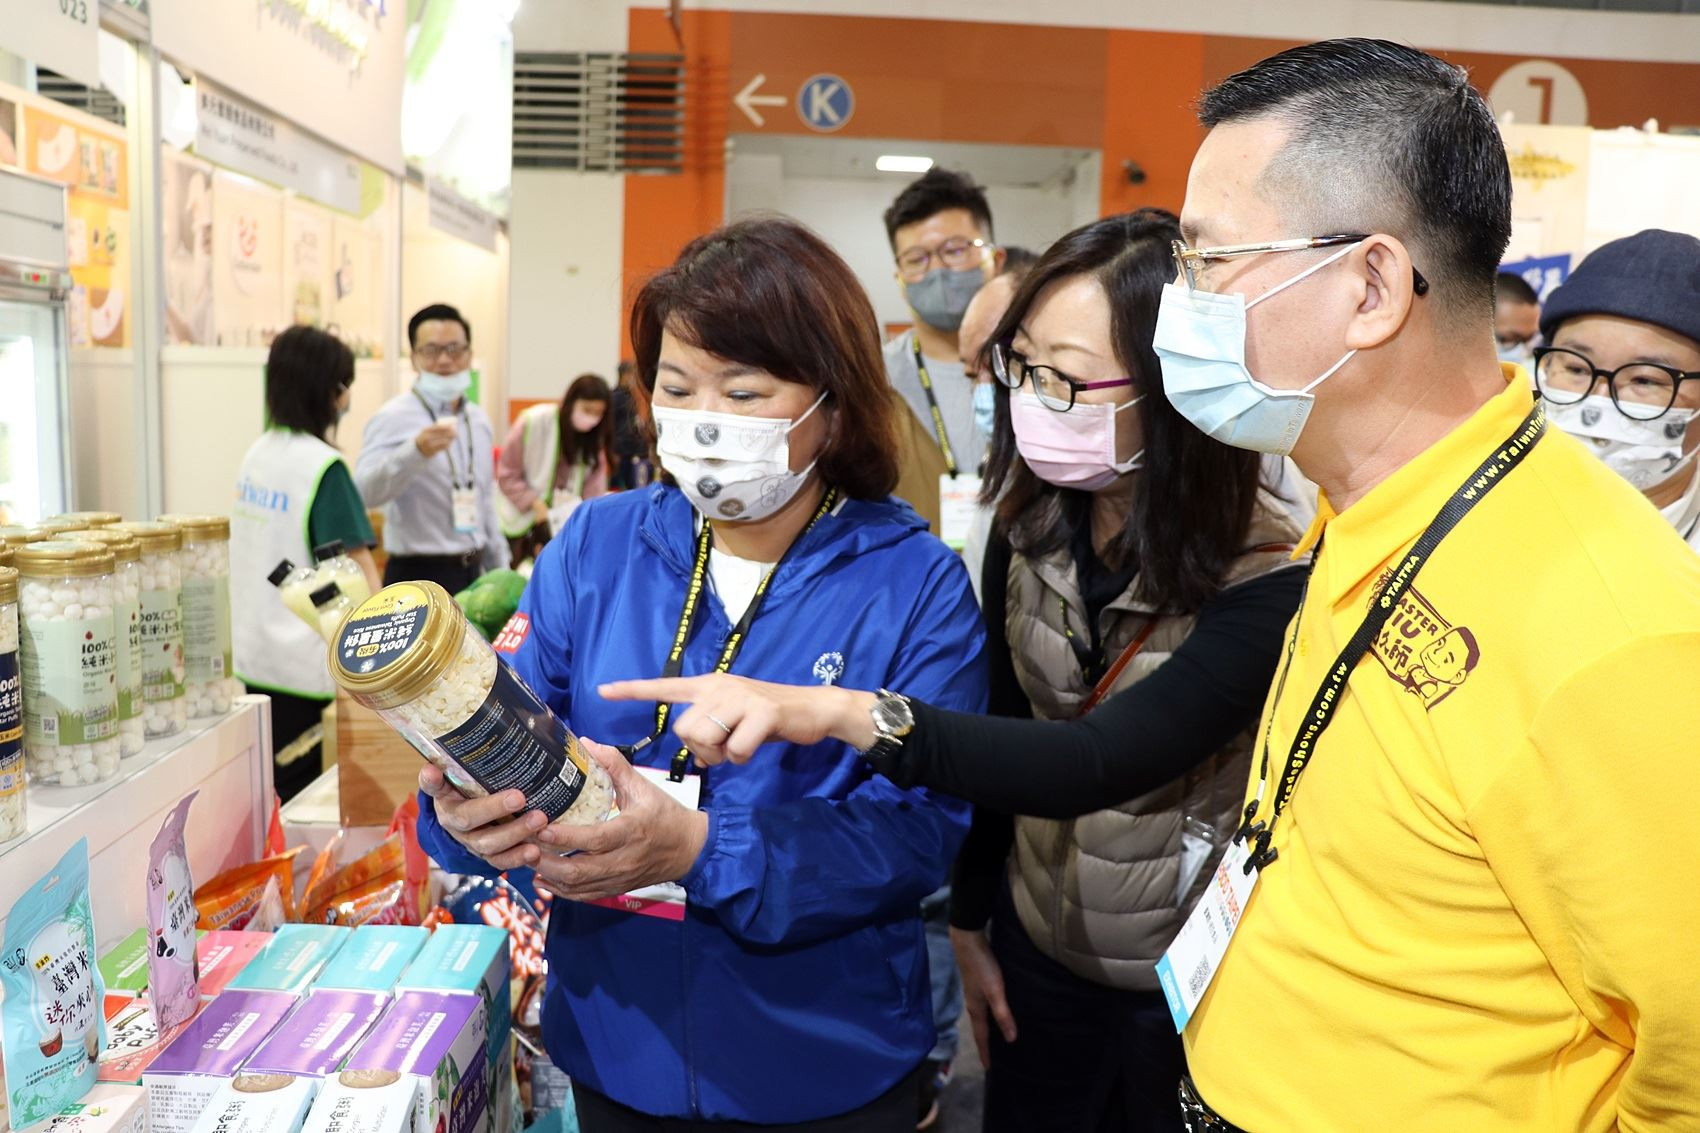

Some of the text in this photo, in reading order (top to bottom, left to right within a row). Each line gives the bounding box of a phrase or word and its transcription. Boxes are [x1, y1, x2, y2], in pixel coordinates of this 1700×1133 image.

[810, 81, 841, 123] K
[1386, 555, 1420, 597] TAITRA
[1391, 612, 1422, 639] IU
[1397, 597, 1439, 637] ASTER
[81, 640, 108, 654] 100%
[379, 637, 409, 654] 100%
[1374, 631, 1413, 671] 久師
[625, 898, 642, 910] VIP
